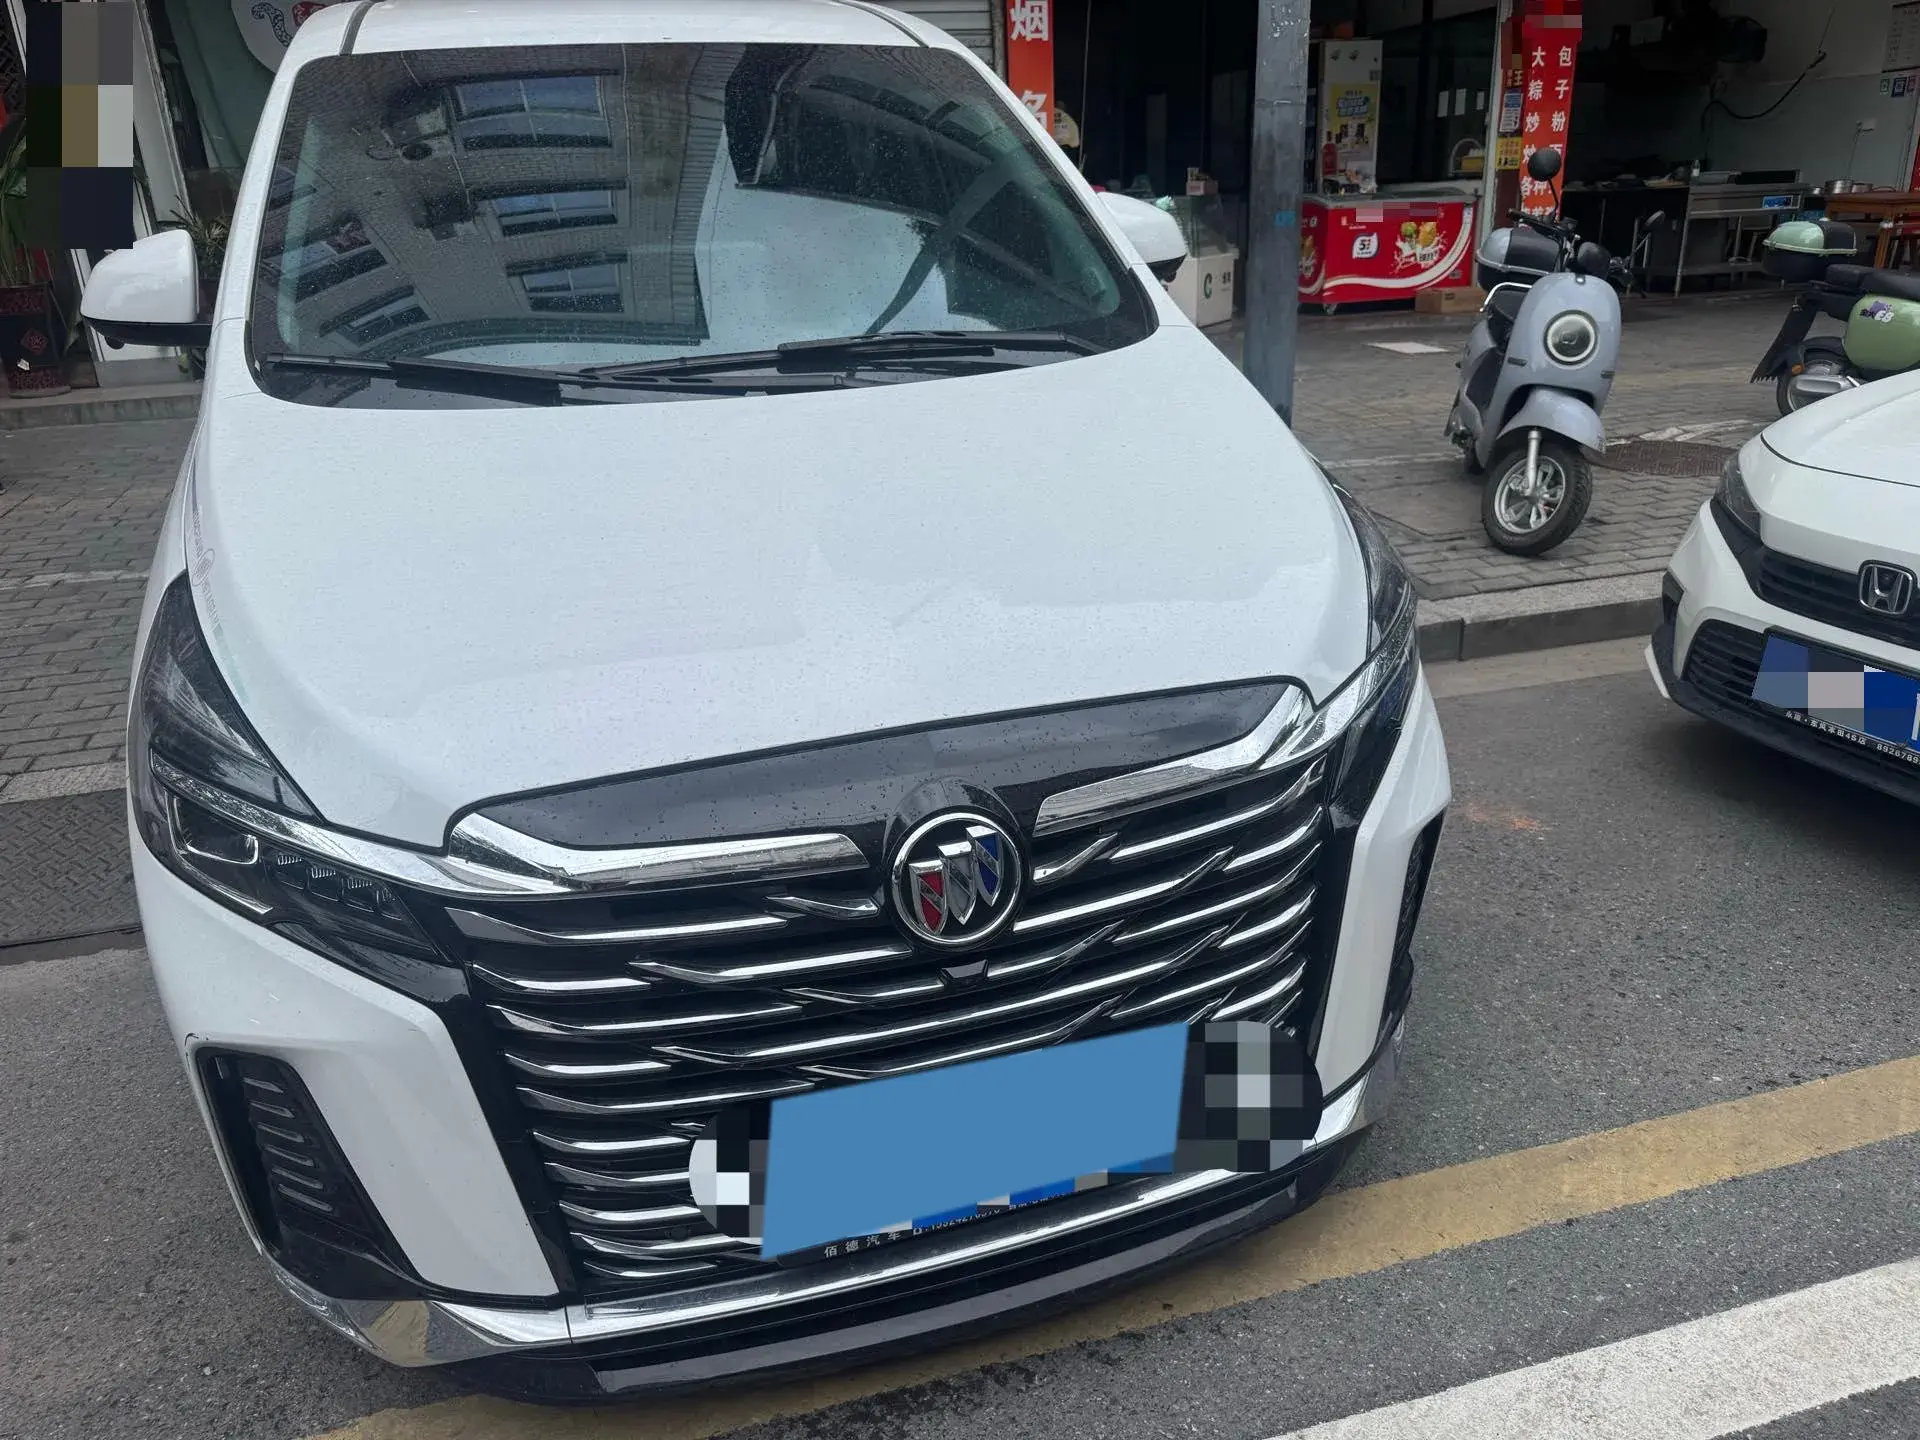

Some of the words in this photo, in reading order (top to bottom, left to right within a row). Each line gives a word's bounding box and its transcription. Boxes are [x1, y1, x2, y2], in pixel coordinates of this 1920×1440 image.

[1876, 743, 1920, 765] 8926789
[823, 1231, 902, 1259] 佰德汽车
